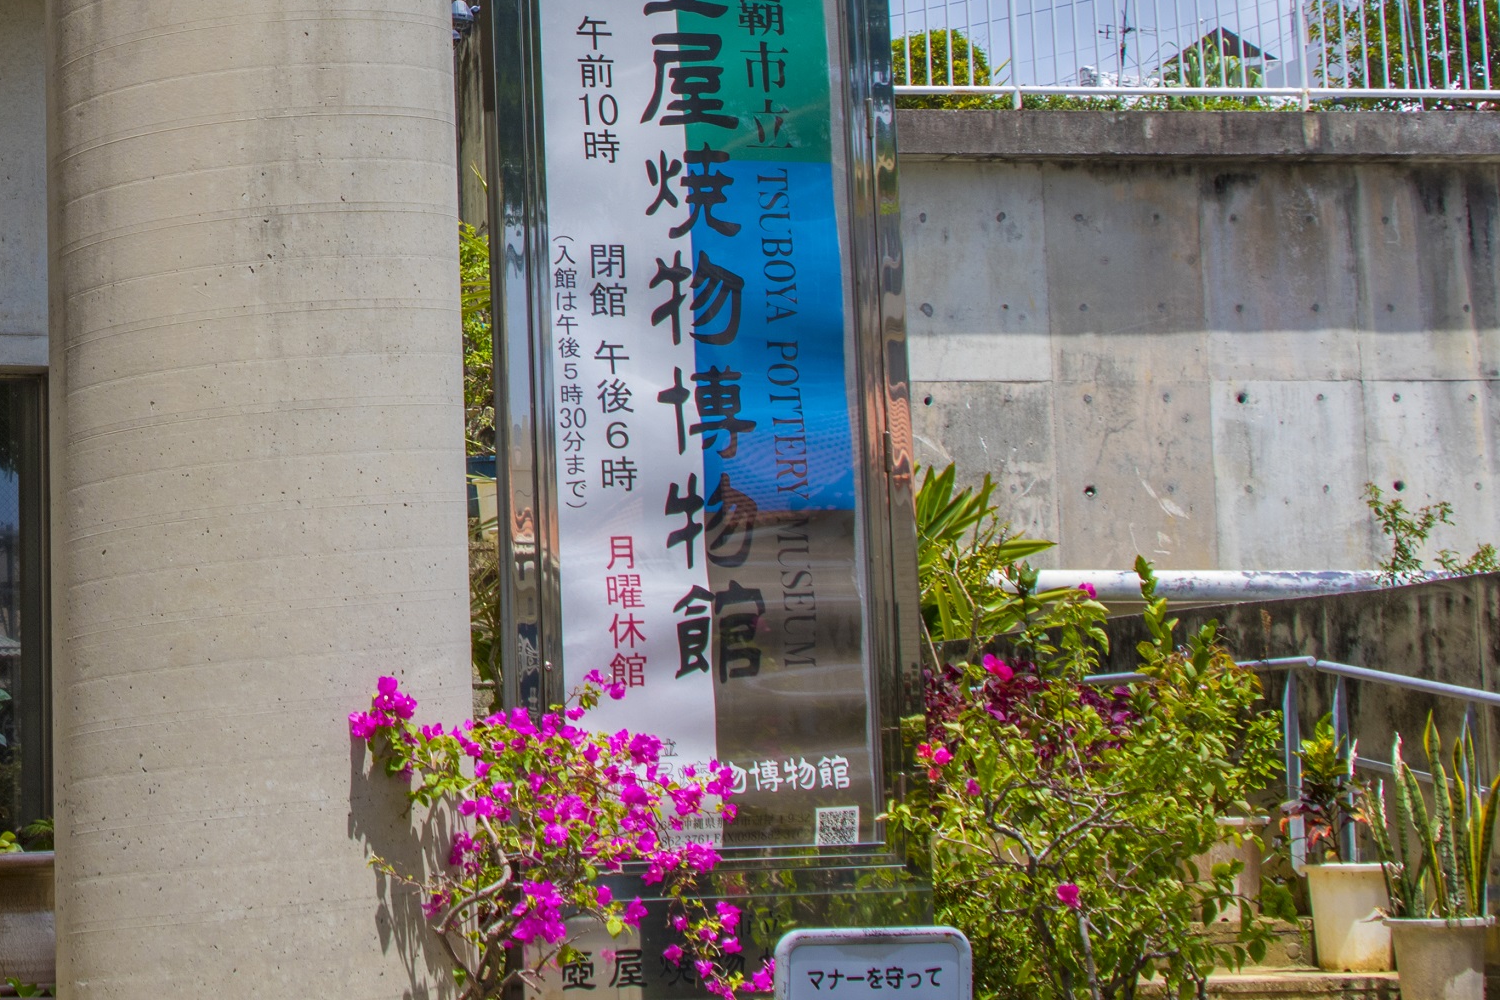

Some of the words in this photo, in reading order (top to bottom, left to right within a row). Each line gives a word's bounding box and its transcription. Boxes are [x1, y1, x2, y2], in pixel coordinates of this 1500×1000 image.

[576, 15, 620, 164] 午前10時
[589, 243, 628, 318] 閉館
[756, 167, 798, 323] TSUBOYA
[594, 340, 638, 492] 午後6時
[765, 340, 809, 501] POTTERY
[606, 535, 647, 687] 月曜休館
[776, 518, 818, 668] MUSEUM
[807, 966, 943, 990] マナーを守って
